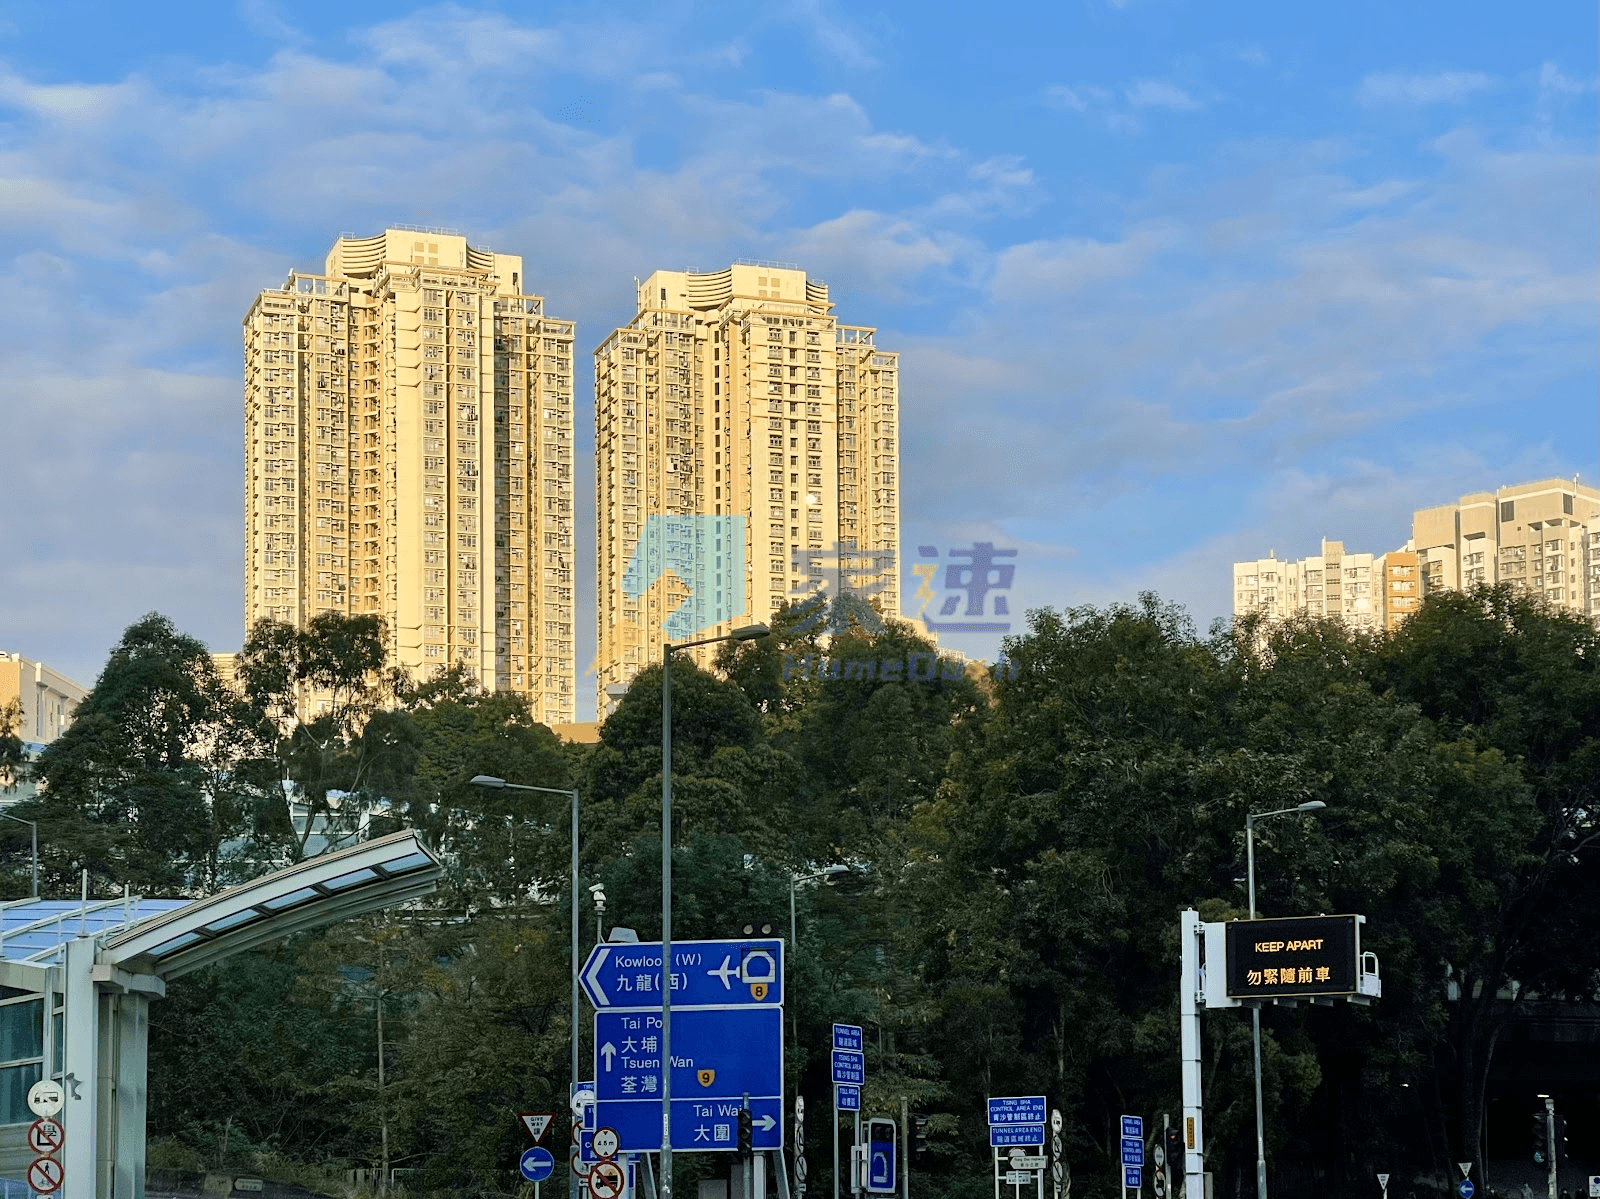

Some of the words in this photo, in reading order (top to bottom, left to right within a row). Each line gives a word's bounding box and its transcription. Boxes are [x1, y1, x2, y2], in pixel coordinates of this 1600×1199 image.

[1255, 941, 1284, 952] KEEP
[1286, 939, 1324, 951] APART
[615, 955, 663, 968] Kowloo
[675, 953, 702, 966] (W)
[1246, 966, 1331, 986] 勿緊隨前車
[755, 986, 763, 997] 8
[621, 1017, 641, 1029] Tai
[646, 1016, 663, 1029] Po
[621, 1035, 658, 1054] 大埔
[621, 1056, 660, 1069] Tsuen
[669, 1055, 694, 1068] Wan
[621, 1074, 658, 1094] 荃灣
[702, 1072, 710, 1084] 9
[693, 1104, 713, 1117] Tai
[694, 1124, 730, 1142] 大圍
